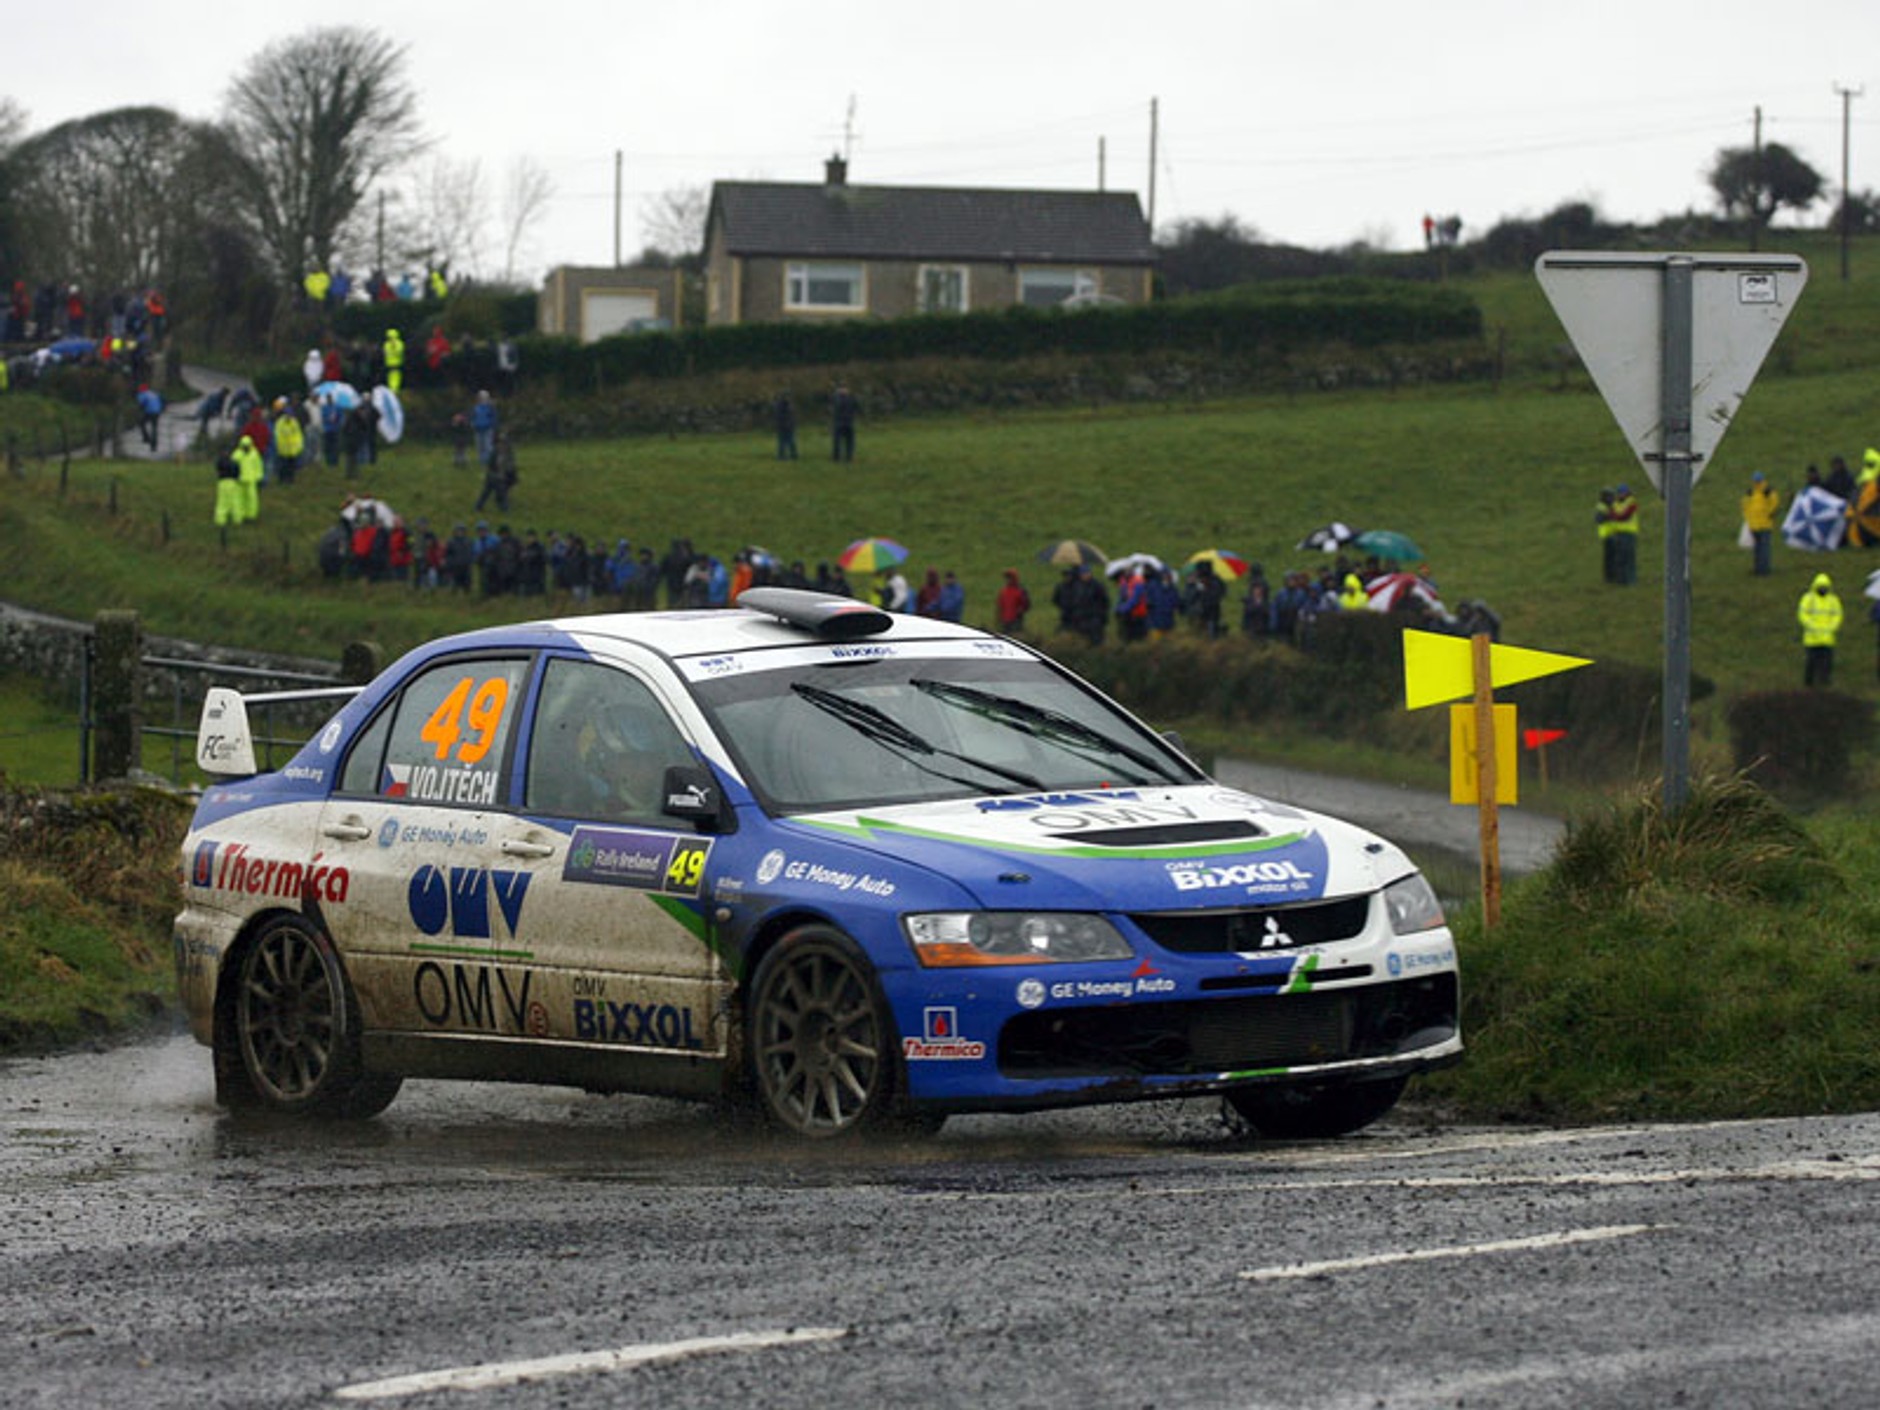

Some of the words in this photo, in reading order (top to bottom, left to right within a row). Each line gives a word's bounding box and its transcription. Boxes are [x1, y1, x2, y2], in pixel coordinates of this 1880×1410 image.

[421, 677, 508, 764] 49
[1031, 806, 1199, 829] OMV
[402, 825, 418, 842] GE
[419, 827, 457, 847] Money
[459, 828, 487, 844] Auto
[668, 849, 705, 886] 49
[785, 861, 804, 879] GE
[806, 864, 853, 891] Money
[853, 874, 896, 897] Auto
[414, 961, 532, 1032] OMV
[574, 977, 608, 996] OMV
[1051, 983, 1074, 998] GE
[1077, 979, 1132, 997] Money
[1136, 977, 1176, 993] Auto
[903, 1037, 985, 1060] Thermica
